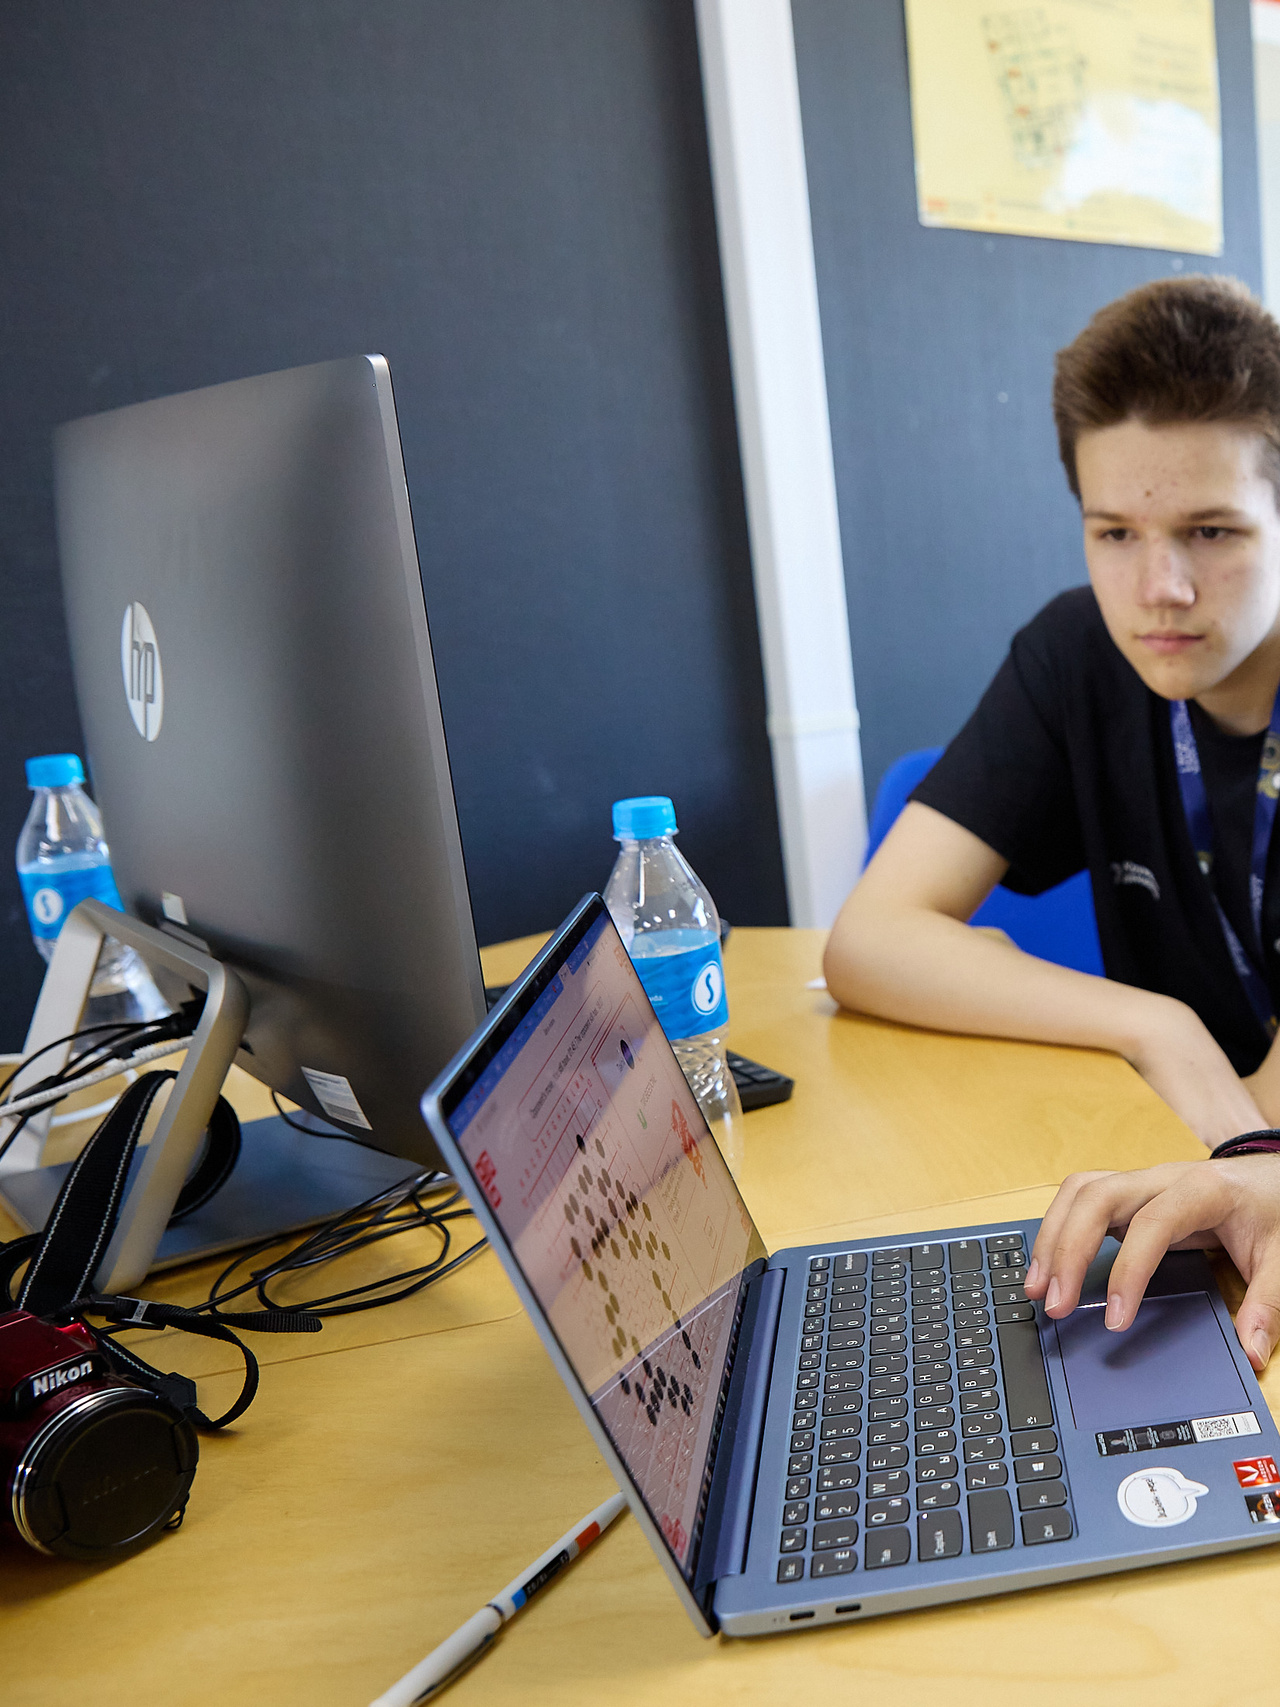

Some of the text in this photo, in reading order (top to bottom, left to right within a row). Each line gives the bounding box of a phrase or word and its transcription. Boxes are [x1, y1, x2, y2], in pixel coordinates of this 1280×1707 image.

[125, 601, 160, 741] hp
[888, 1315, 900, 1323] Щ
[890, 1334, 901, 1342] Ш
[961, 1337, 973, 1345] M
[962, 1358, 975, 1366] N
[33, 1360, 93, 1398] Nikon
[919, 1374, 932, 1382] H
[964, 1380, 977, 1388] B
[919, 1396, 933, 1404] G
[967, 1425, 981, 1433] C
[873, 1433, 887, 1442] R
[986, 1437, 997, 1445] Ч
[921, 1443, 935, 1452] D
[970, 1450, 984, 1459] X
[872, 1459, 887, 1467] E
[939, 1455, 950, 1464] Ы
[988, 1462, 1000, 1470] Я
[888, 1471, 902, 1480] Ц
[921, 1469, 936, 1478] S
[972, 1477, 986, 1486] Z
[872, 1483, 886, 1494] W
[888, 1498, 902, 1507] Й
[923, 1496, 937, 1504] A
[838, 1505, 852, 1513] 2
[871, 1512, 887, 1523] Q
